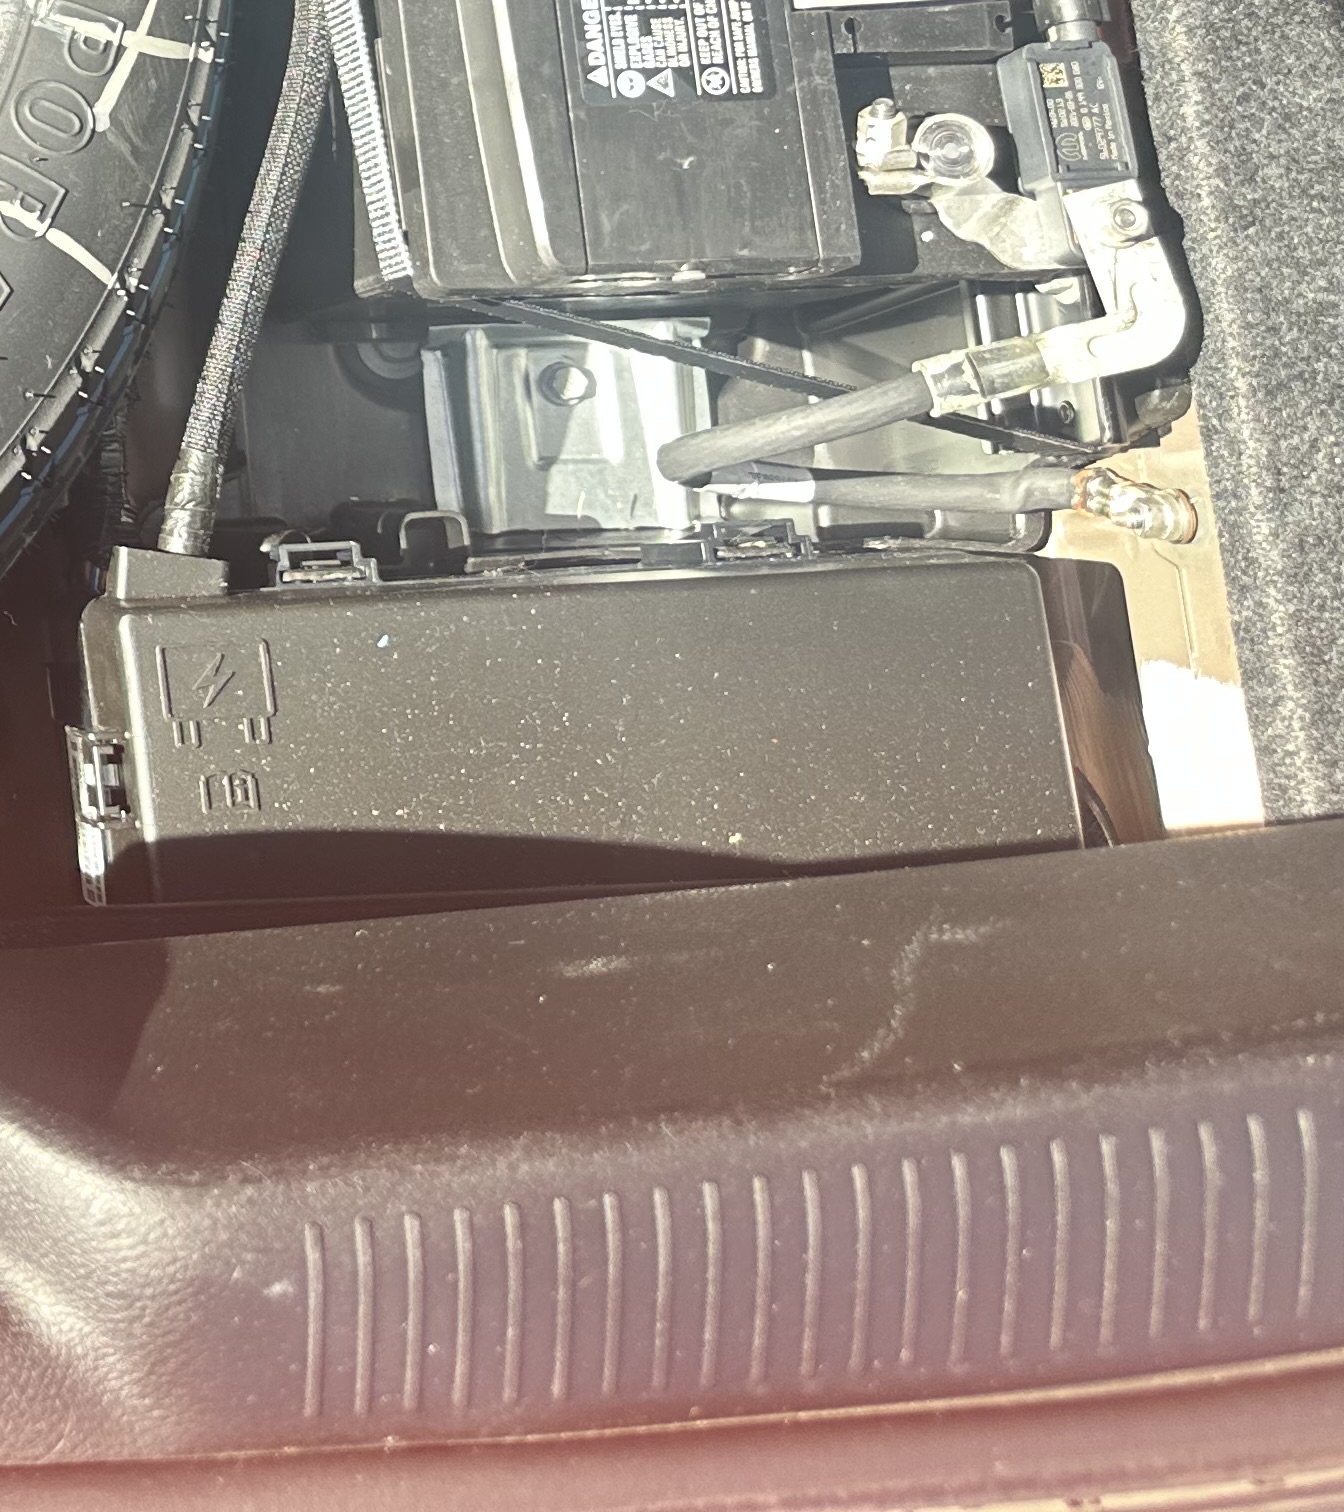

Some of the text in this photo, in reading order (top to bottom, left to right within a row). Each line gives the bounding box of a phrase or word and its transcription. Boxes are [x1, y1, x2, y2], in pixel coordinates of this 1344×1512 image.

[691, 2, 705, 15] OF
[739, 0, 751, 9] IF
[693, 16, 708, 37] OUT
[706, 15, 719, 28] OF
[730, 21, 744, 40] SAFE
[611, 37, 627, 69] SHIELD
[623, 14, 643, 68] EXPLOSIVE
[649, 17, 667, 67] CAN CAUSE
[661, 16, 679, 67] BLINDNESS
[672, 16, 690, 67] OR INJURY.
[696, 38, 712, 64] KEEP
[707, 28, 724, 64] REACH
[732, 41, 746, 57] FOR
